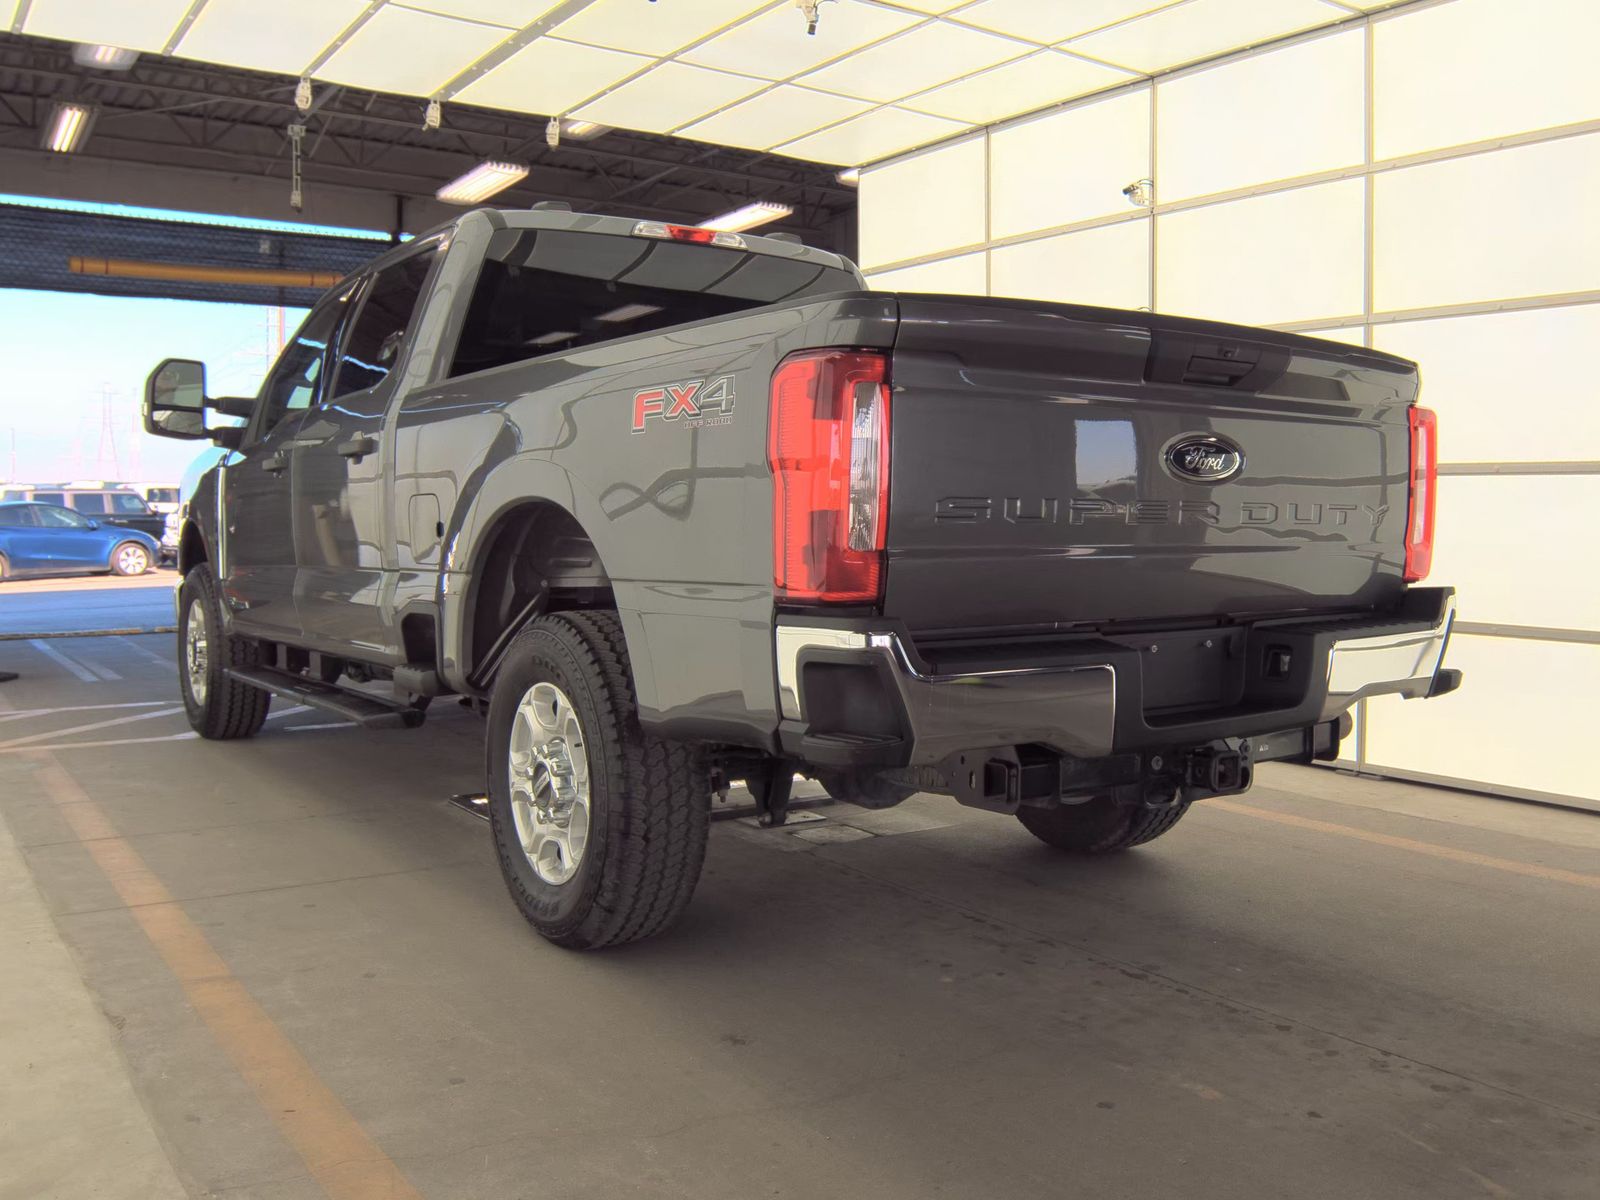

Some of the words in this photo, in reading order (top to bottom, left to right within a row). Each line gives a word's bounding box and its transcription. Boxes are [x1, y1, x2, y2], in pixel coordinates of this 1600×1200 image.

[631, 374, 736, 435] FX4
[1179, 445, 1226, 471] Ford
[934, 496, 1221, 526] SUPER
[1239, 502, 1391, 527] DUTY
